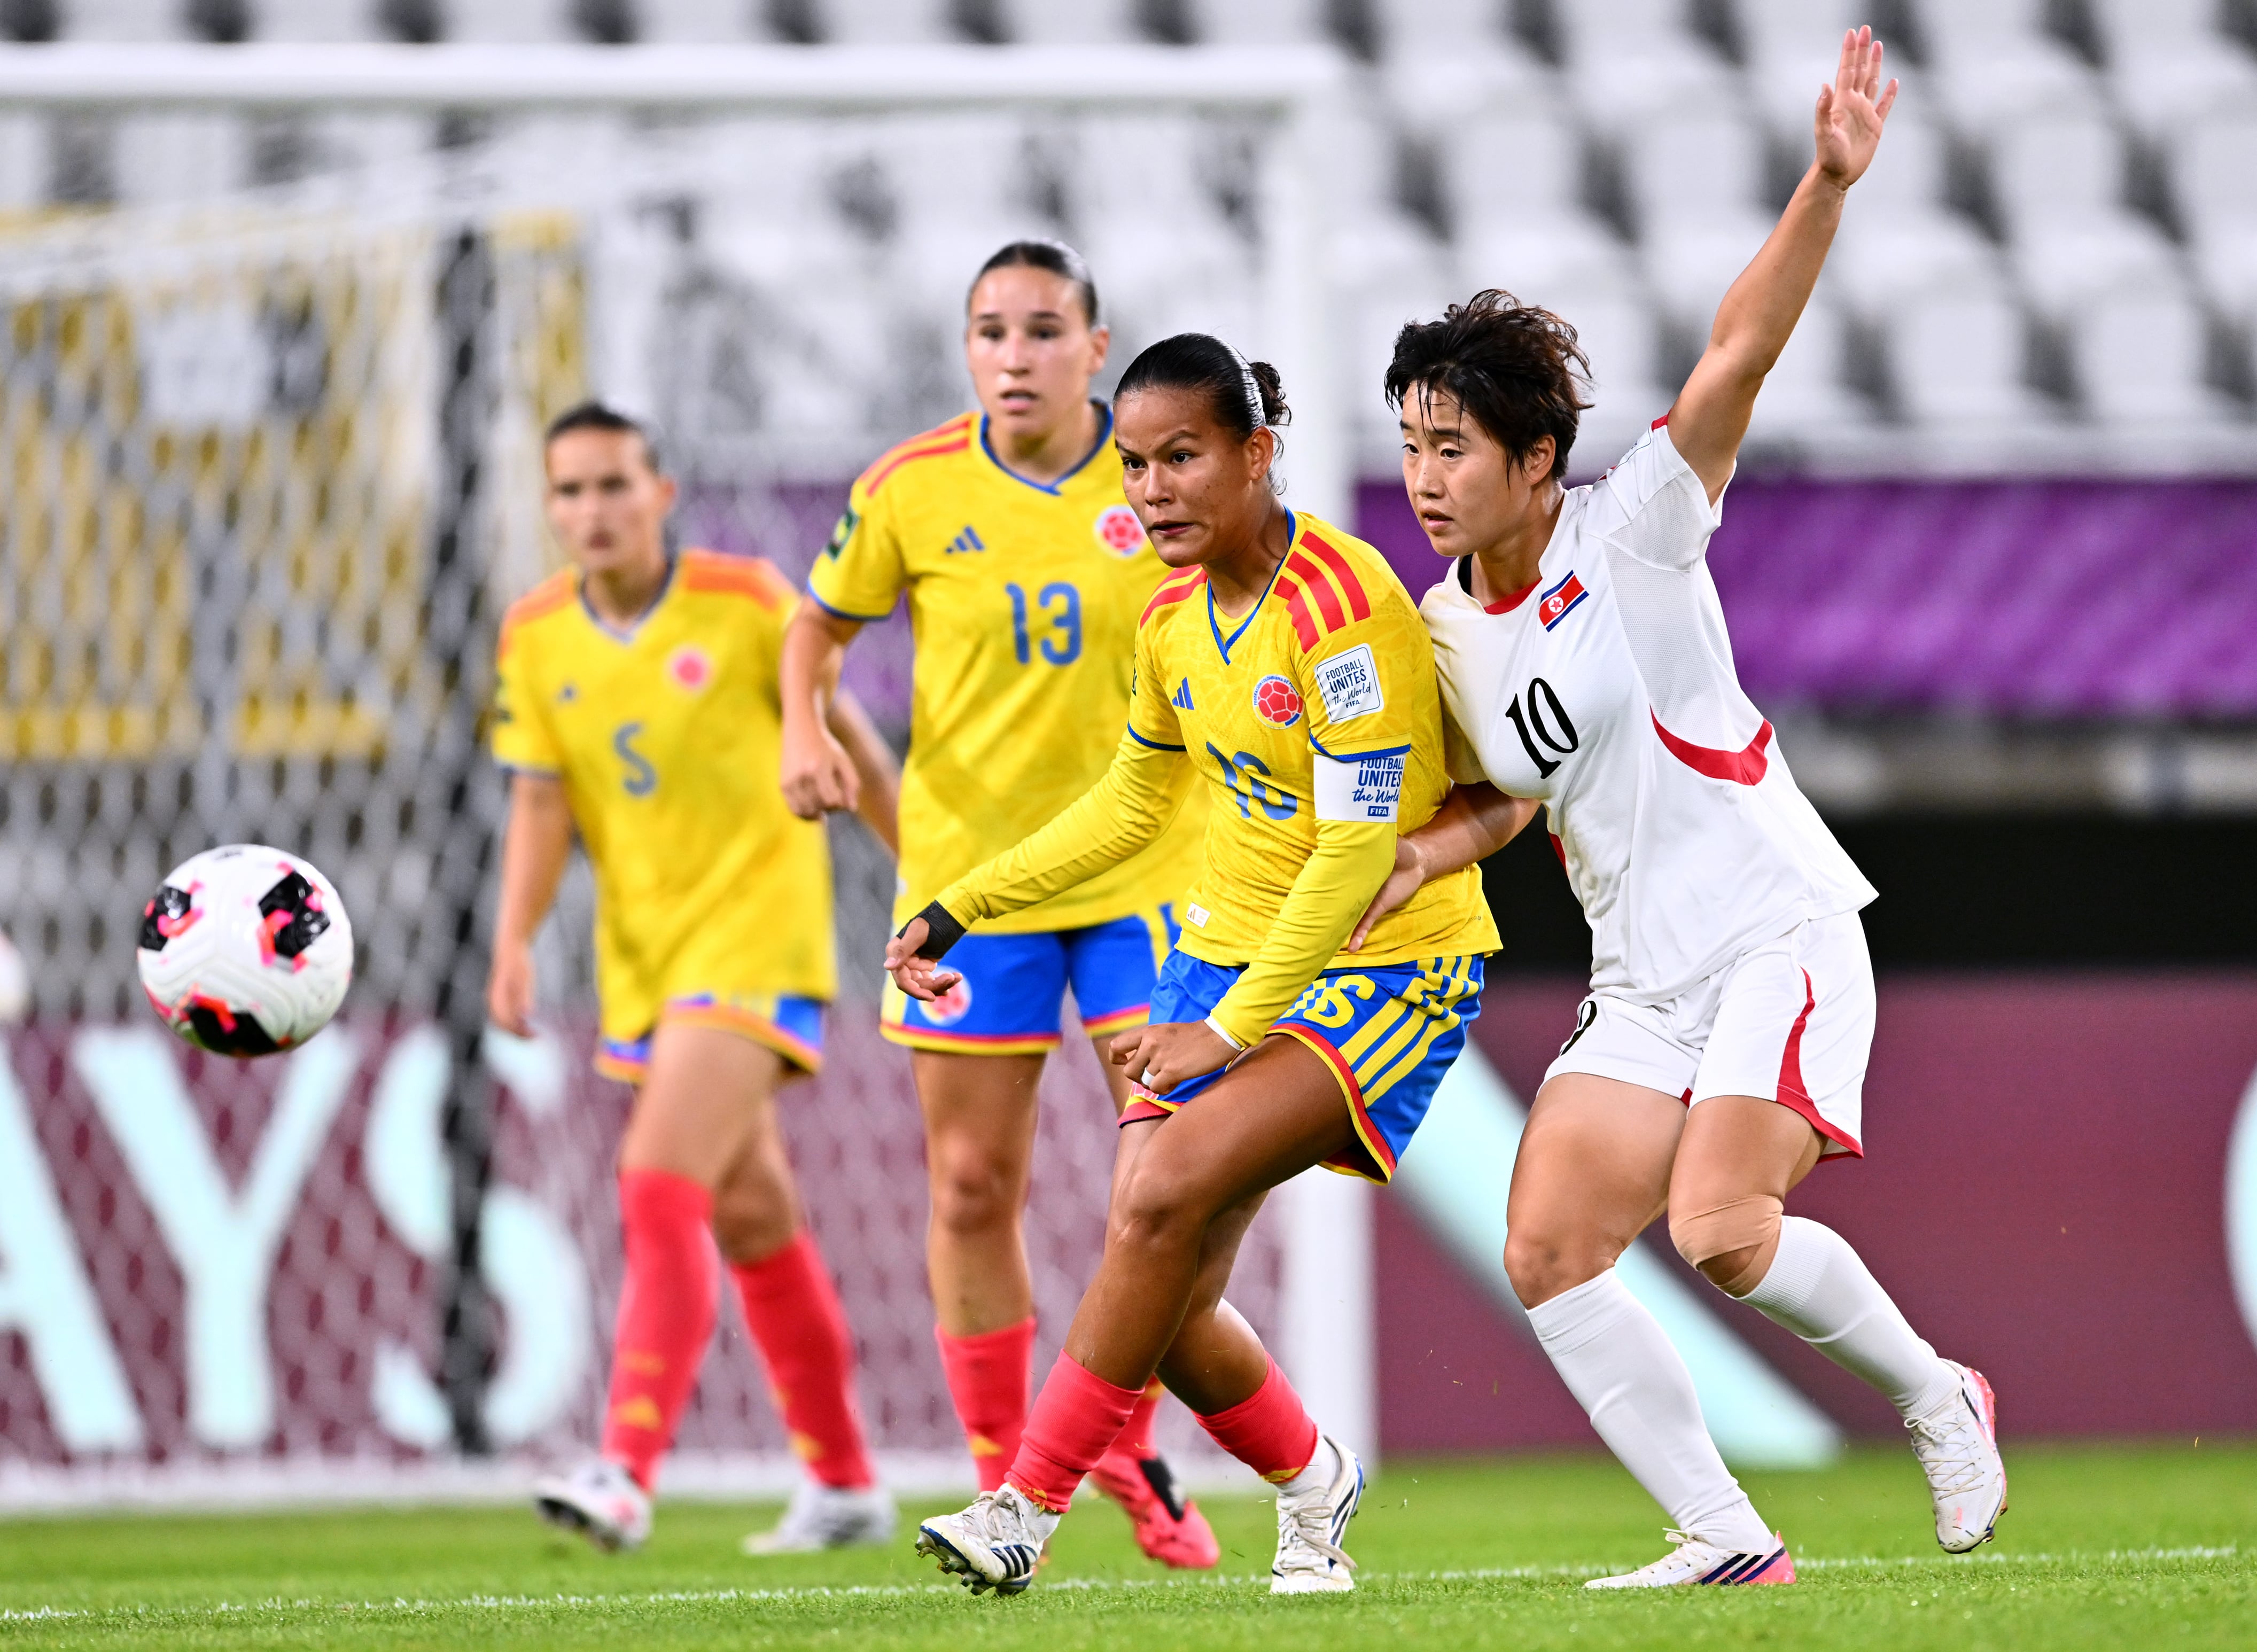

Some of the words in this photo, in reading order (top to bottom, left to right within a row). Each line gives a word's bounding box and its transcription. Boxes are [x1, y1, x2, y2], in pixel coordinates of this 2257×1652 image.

[1005, 581, 1083, 667] 13
[1326, 658, 1364, 681] FOOTBALL
[1329, 668, 1367, 693] UNITES
[1332, 693, 1347, 705] the
[1347, 681, 1371, 700] World
[1345, 699, 1360, 708] FIFA
[1505, 677, 1579, 780] 10
[1360, 757, 1404, 769] FOOTBALL
[1205, 741, 1297, 820] 16
[1358, 769, 1403, 787] UNITES
[1352, 788, 1374, 802] the
[1369, 807, 1388, 815] FIFA
